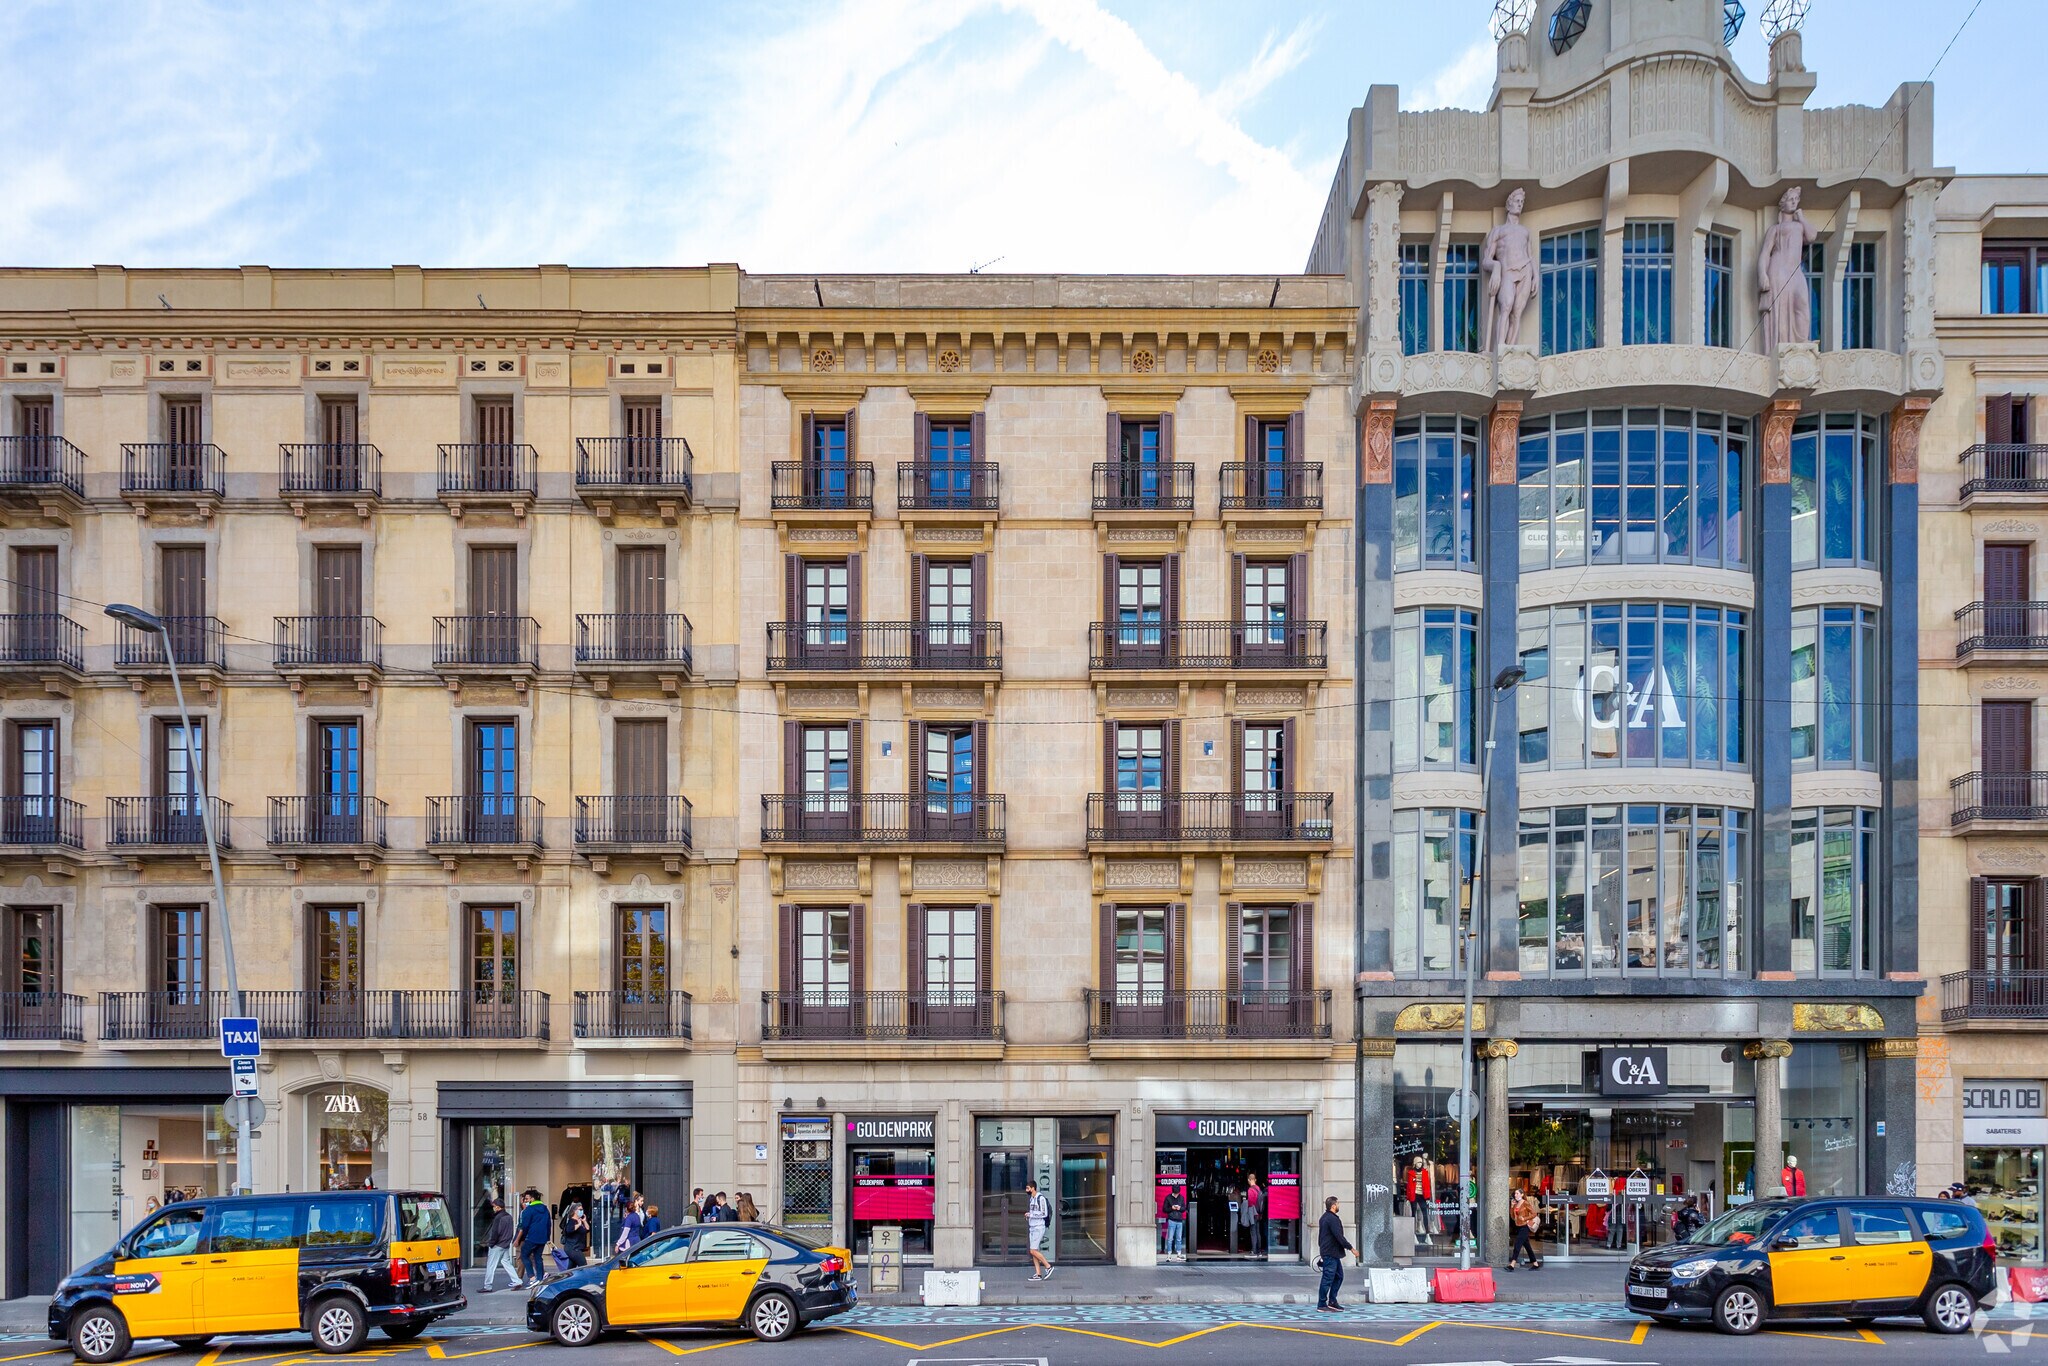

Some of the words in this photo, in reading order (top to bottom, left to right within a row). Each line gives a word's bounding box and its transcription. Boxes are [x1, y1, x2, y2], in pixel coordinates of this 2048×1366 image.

[1575, 665, 1687, 729] C&A
[224, 1031, 258, 1044] TAXI
[1612, 1056, 1660, 1085] C&A
[324, 1095, 362, 1113] ZARA
[1963, 1088, 2011, 1108] SCALA
[2016, 1088, 2041, 1108] DEI
[417, 1112, 428, 1121] 58
[856, 1121, 933, 1138] GOLDENPARK
[1198, 1120, 1275, 1137] GOLDENPARK
